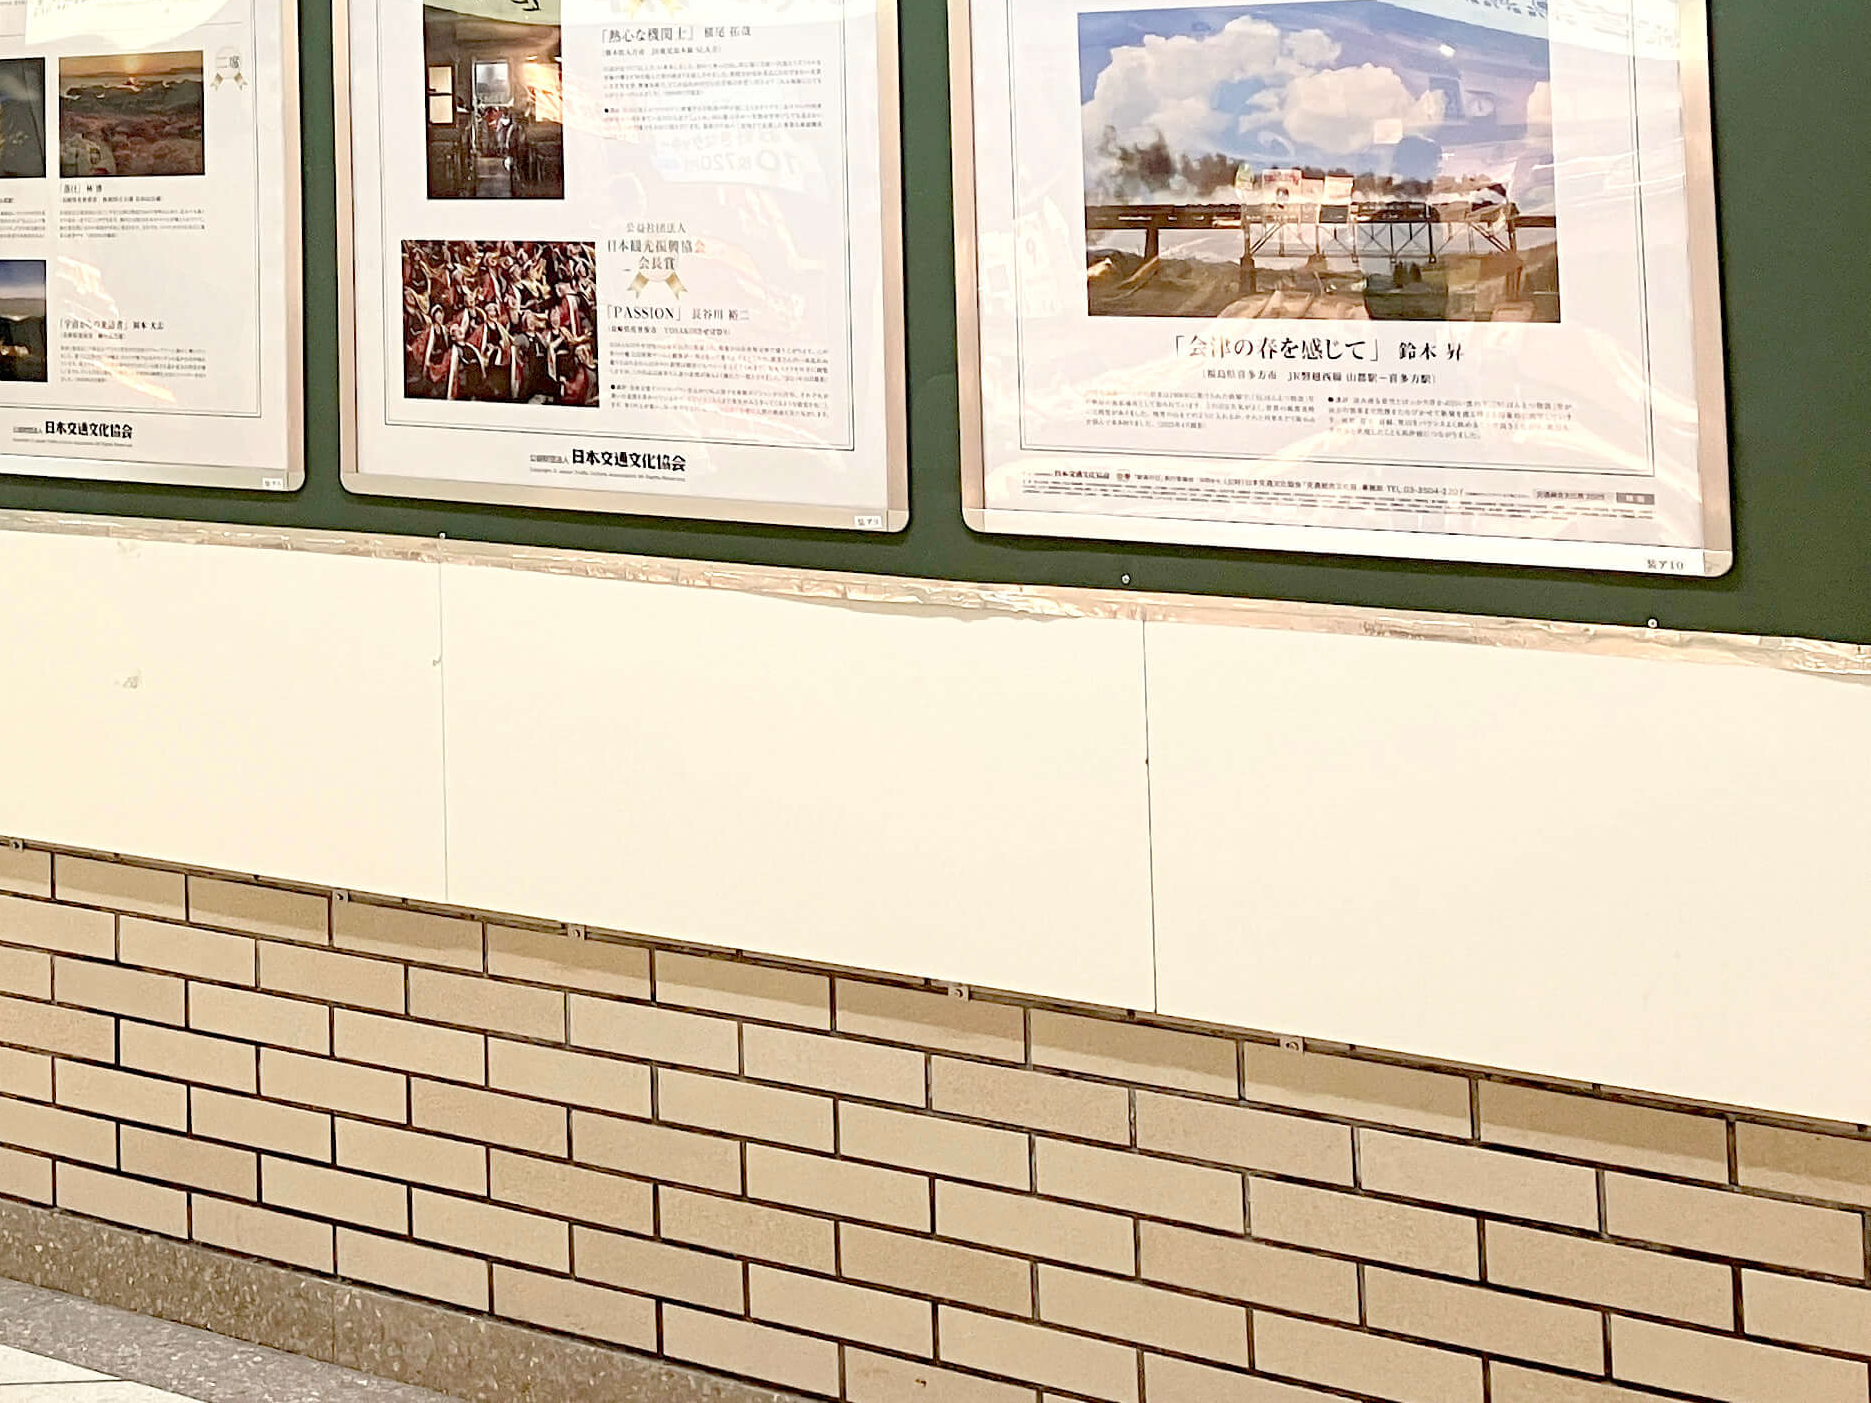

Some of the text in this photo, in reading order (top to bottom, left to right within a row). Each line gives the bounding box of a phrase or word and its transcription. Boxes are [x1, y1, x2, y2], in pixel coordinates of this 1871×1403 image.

[607, 239, 706, 253] 日本観光振興協会
[638, 256, 676, 270] 会長賞
[692, 308, 723, 320] 長谷川
[1175, 334, 1380, 362] 「会津の春を感じて」
[1398, 341, 1437, 361] 鈴木
[45, 420, 133, 439] 日本交通文化協会
[572, 448, 686, 472] 日本交通文化協会
